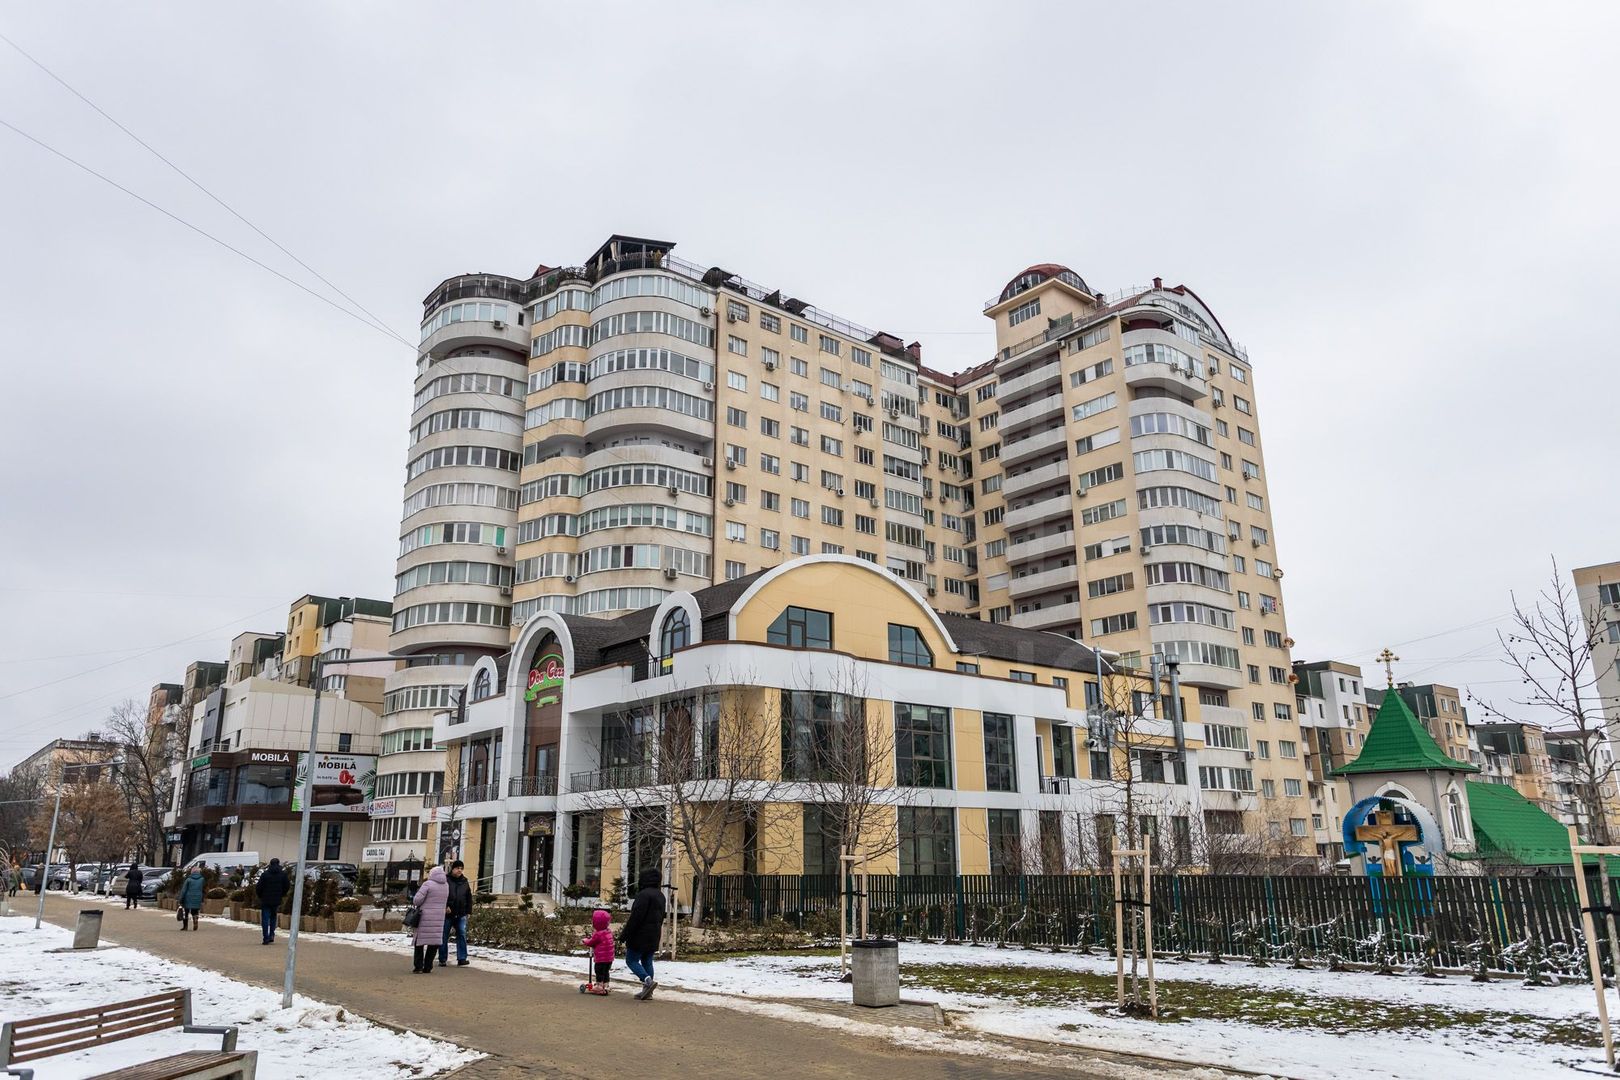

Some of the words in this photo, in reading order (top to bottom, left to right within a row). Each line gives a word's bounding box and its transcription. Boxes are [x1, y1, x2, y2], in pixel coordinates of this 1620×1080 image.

[528, 669, 545, 689] Don
[251, 751, 290, 763] MOBILĂ
[317, 761, 357, 770] MOBILĂ
[339, 769, 356, 785] 0%
